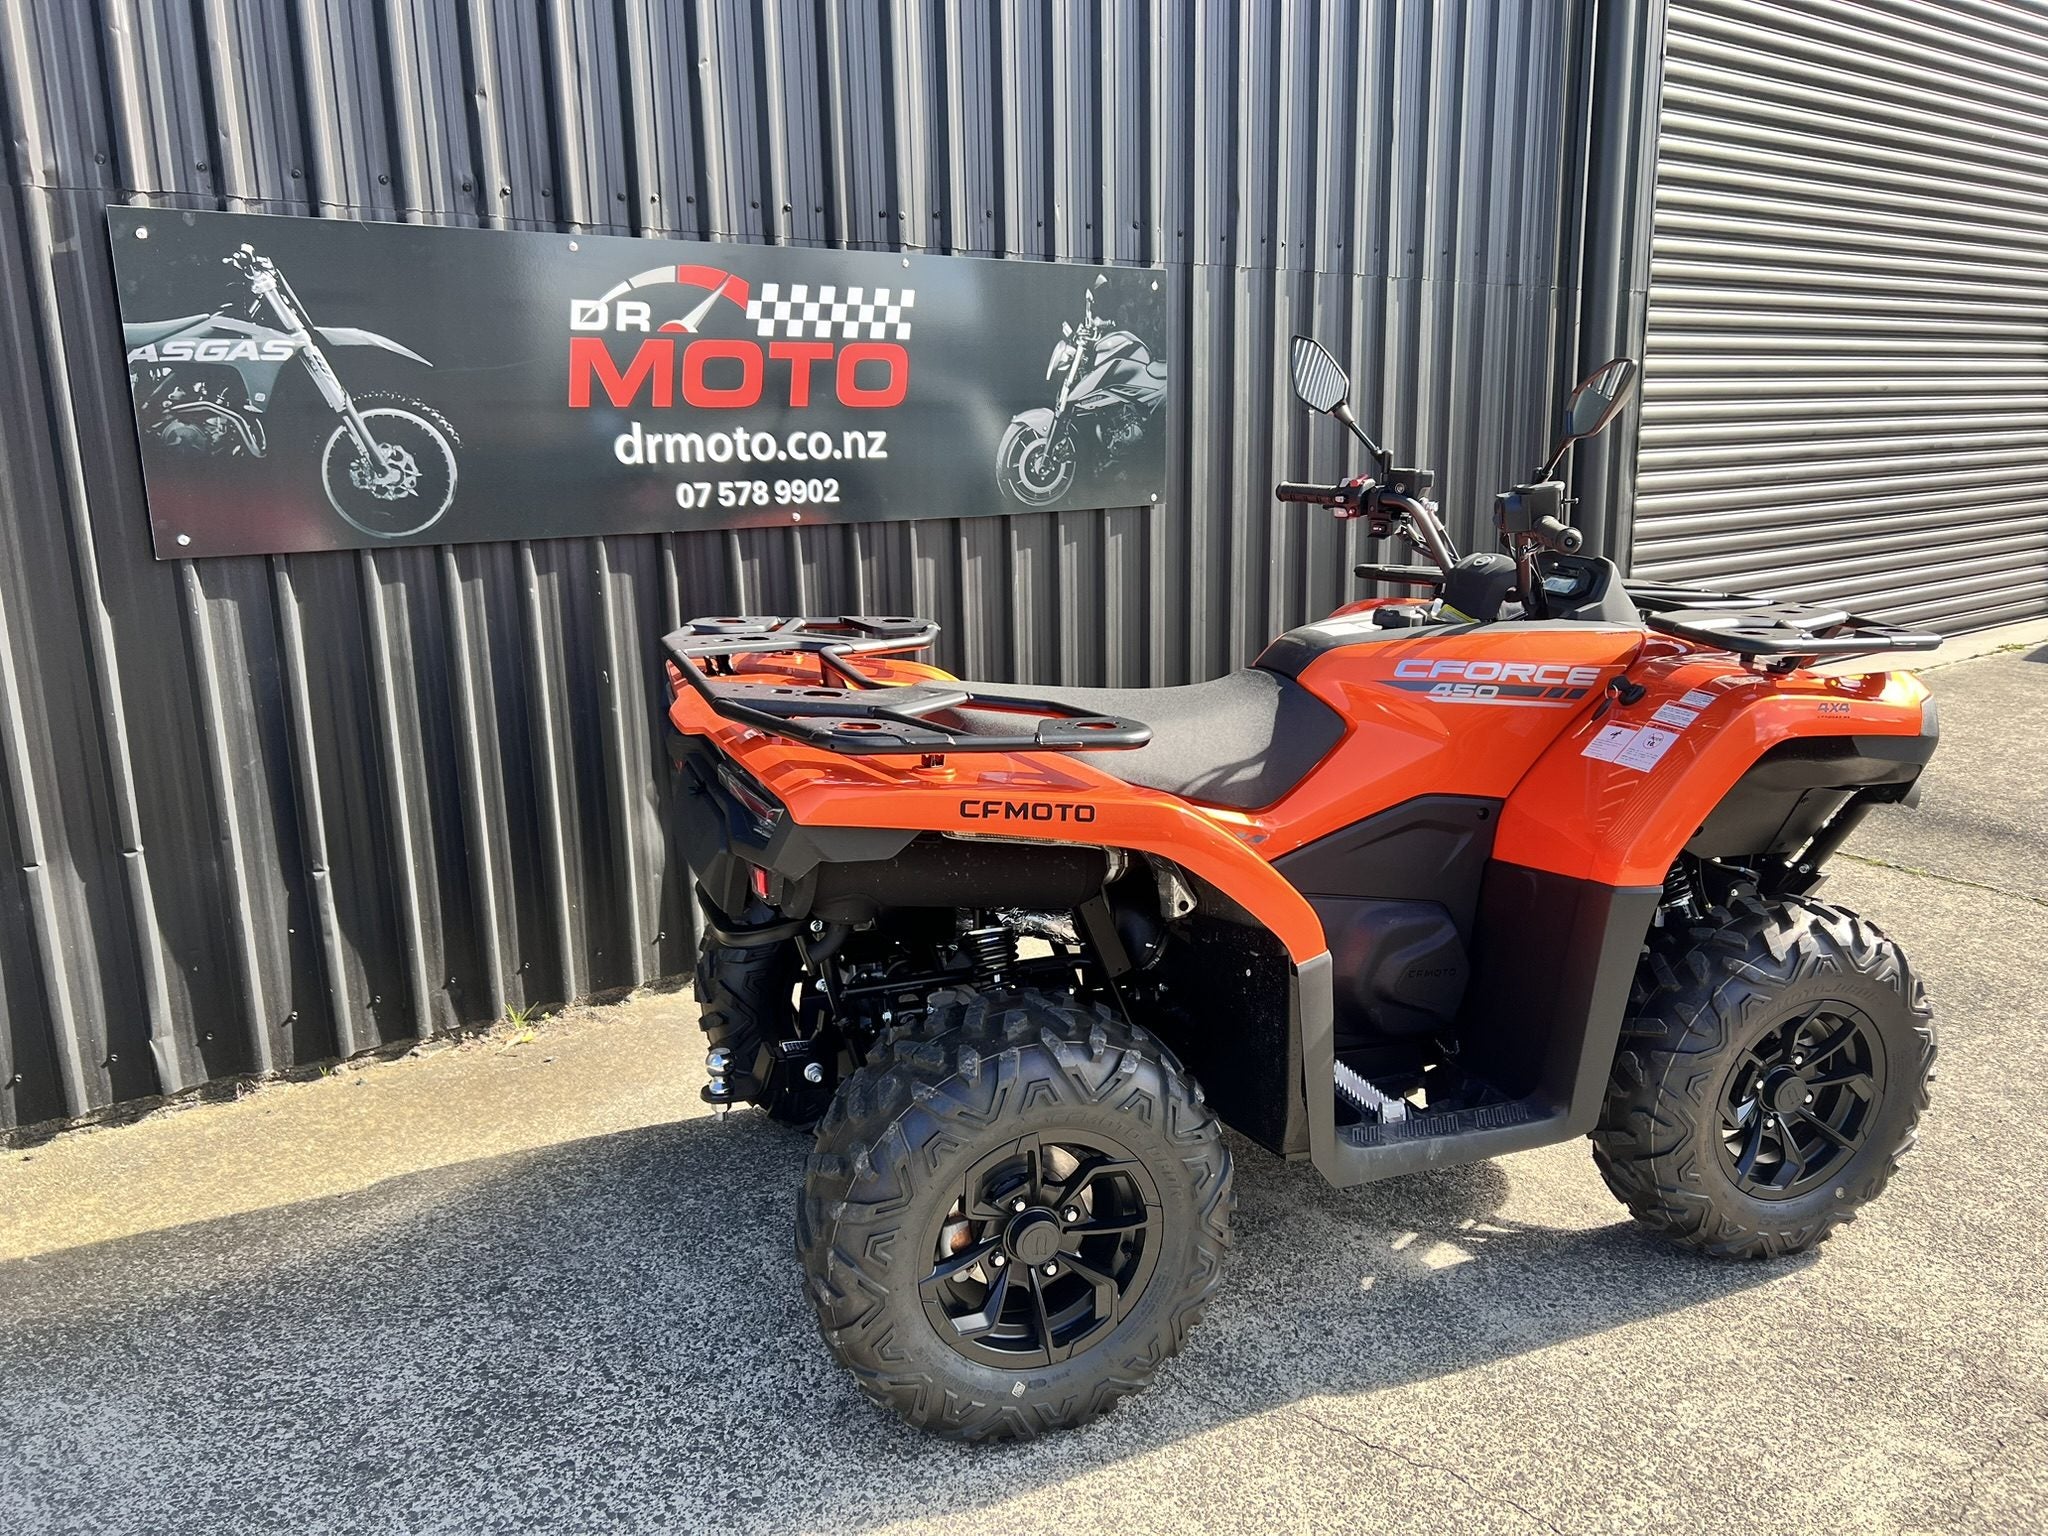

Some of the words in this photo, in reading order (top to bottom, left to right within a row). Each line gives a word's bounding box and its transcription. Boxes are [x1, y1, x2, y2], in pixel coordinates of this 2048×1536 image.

[570, 298, 650, 333] DR
[568, 336, 910, 409] MOTO
[614, 421, 888, 465] drmoto.co.nz
[676, 481, 714, 508] 07
[718, 480, 769, 507] 578
[774, 477, 840, 505] 9902
[1393, 658, 1601, 686] CFORCE
[1428, 682, 1500, 699] 450
[959, 799, 1097, 824] CFMOTO
